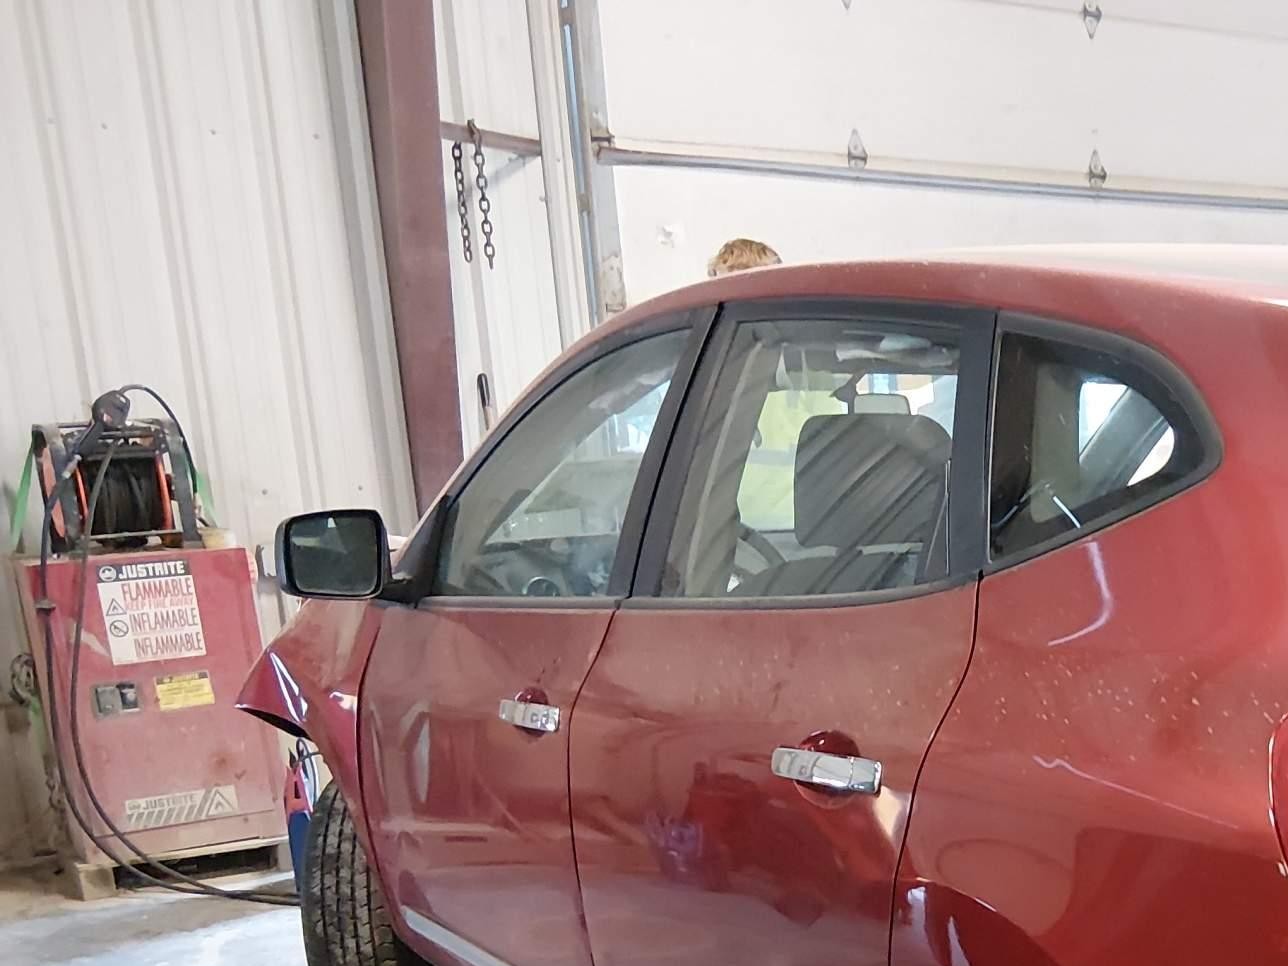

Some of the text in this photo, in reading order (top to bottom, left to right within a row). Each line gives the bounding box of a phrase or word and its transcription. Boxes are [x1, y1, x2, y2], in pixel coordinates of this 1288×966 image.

[118, 560, 185, 579] JUSTRITE
[121, 577, 193, 602] FLAMMABLE
[129, 607, 199, 633] INFLAMABLE
[133, 631, 204, 658] INFLAMMABLE
